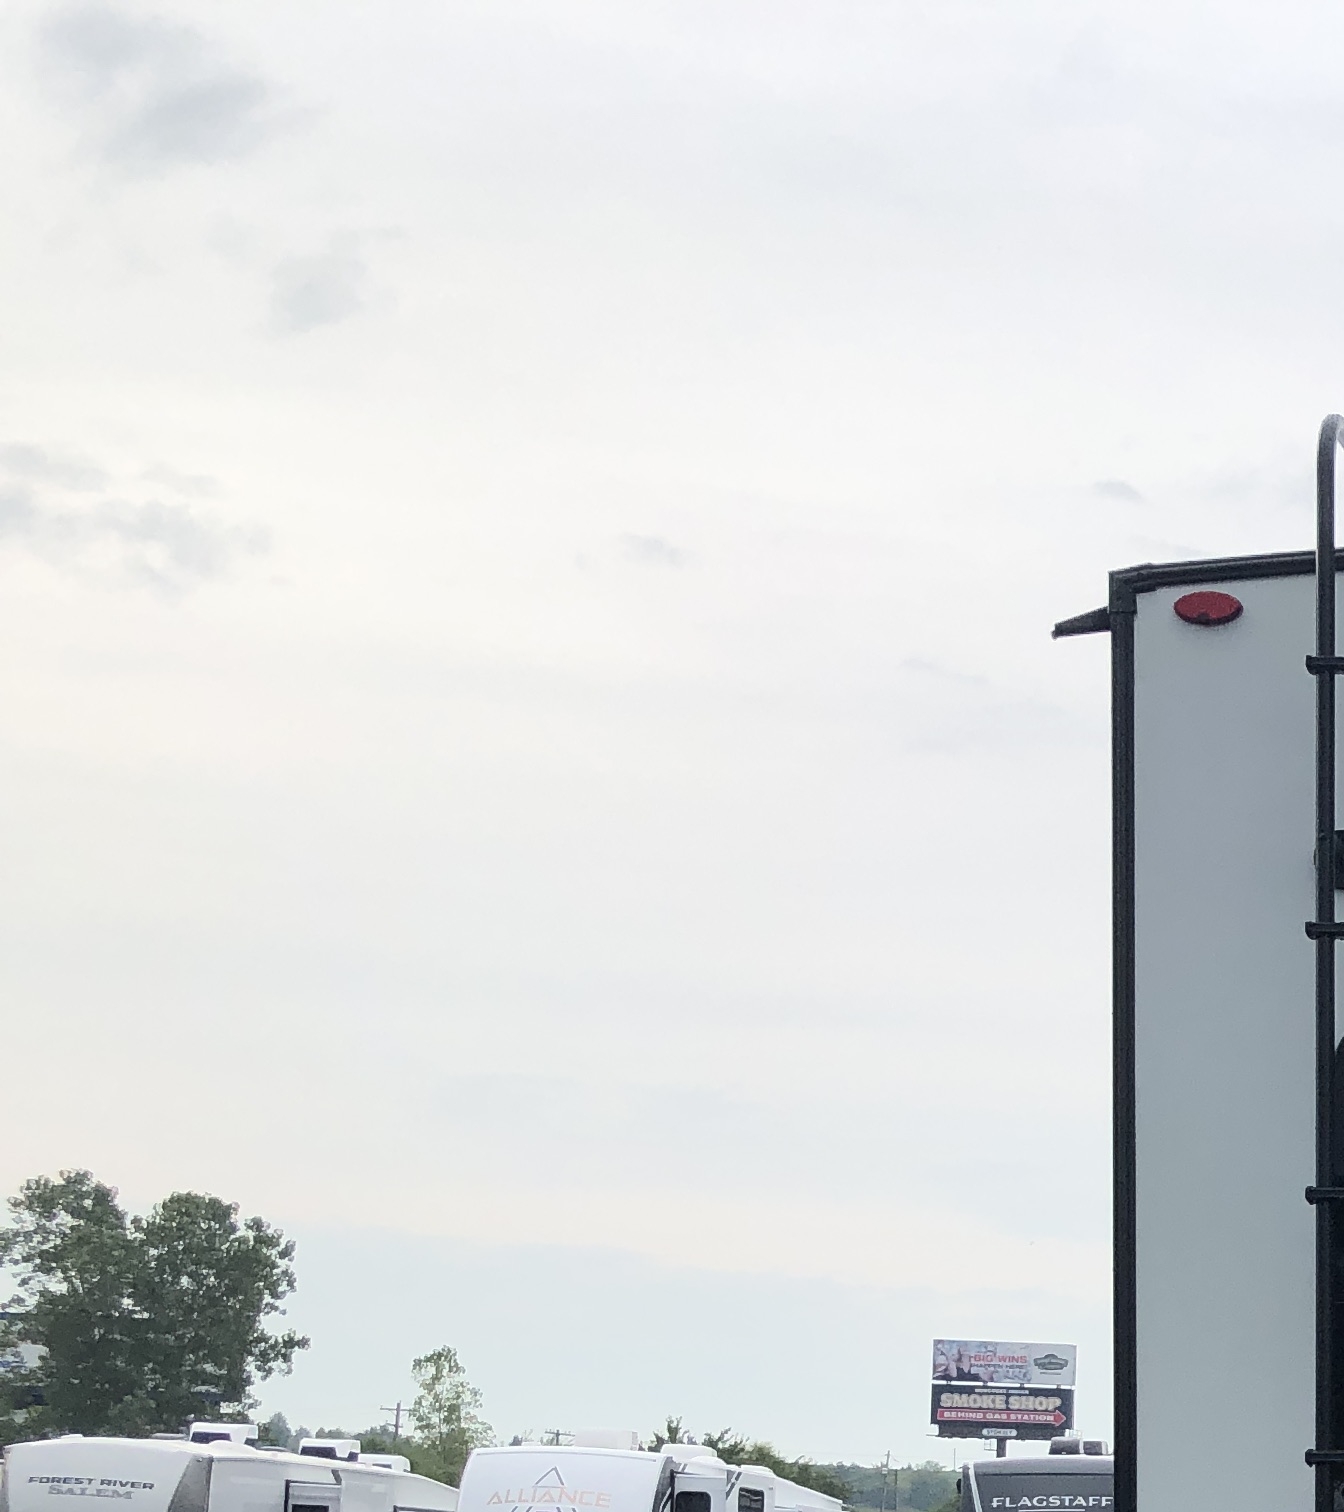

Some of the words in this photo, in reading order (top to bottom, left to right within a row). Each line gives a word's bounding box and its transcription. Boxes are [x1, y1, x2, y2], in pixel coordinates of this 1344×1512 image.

[998, 1355, 1028, 1364] WINS
[940, 1393, 1007, 1409] SMOKE
[1008, 1395, 1062, 1411] SHOP
[943, 1411, 983, 1419] BEHIND
[986, 1412, 1008, 1420] GAS
[1010, 1413, 1055, 1421] STATION
[28, 1476, 95, 1486] FOREST
[99, 1478, 155, 1490] RIVER
[47, 1484, 135, 1499] SALEM
[487, 1488, 612, 1508] ALLIANCE
[991, 1496, 1113, 1507] FLAGSTAFF
